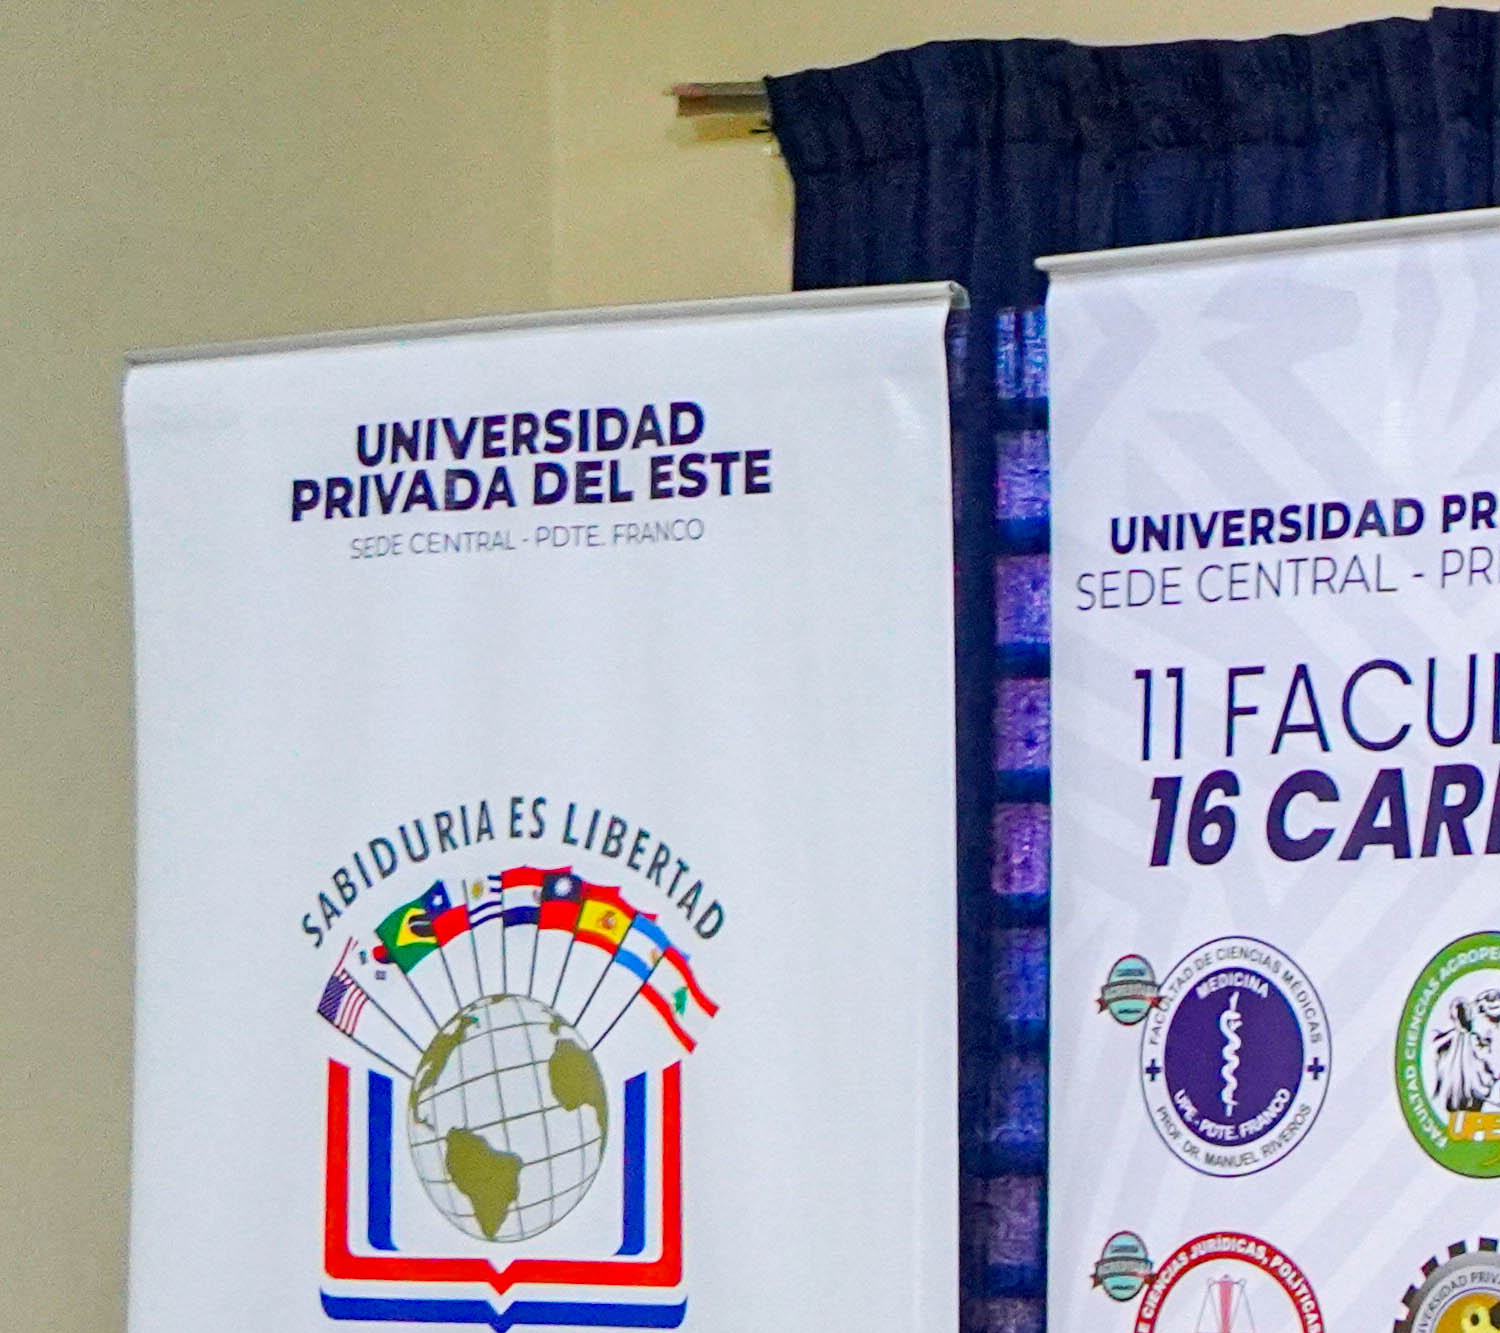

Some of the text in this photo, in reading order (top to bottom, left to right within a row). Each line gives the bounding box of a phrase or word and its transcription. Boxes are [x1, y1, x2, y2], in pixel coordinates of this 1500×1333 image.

[356, 401, 705, 466] UNIVERSIDAD
[291, 448, 773, 523] PRIVADA DEL ESTE
[349, 518, 705, 560] SEDE CENTRAL PDTE. FRANCO
[1109, 498, 1424, 555] UNIVERSIDAD
[1075, 567, 1182, 612] SEDE
[1197, 553, 1398, 603] CENTRAL
[1134, 667, 1185, 761] 11
[1147, 769, 1238, 867] 16
[300, 796, 726, 949] SABIDURIA ES LIBERTAD
[1195, 972, 1269, 999] MEDICINA
[1216, 946, 1281, 974] CIENCIAS
[1404, 978, 1441, 1061] CIENCIAS
[1205, 1103, 1312, 1168] MANUEL RIVEROS
[1404, 1065, 1450, 1149] FACULTAD
